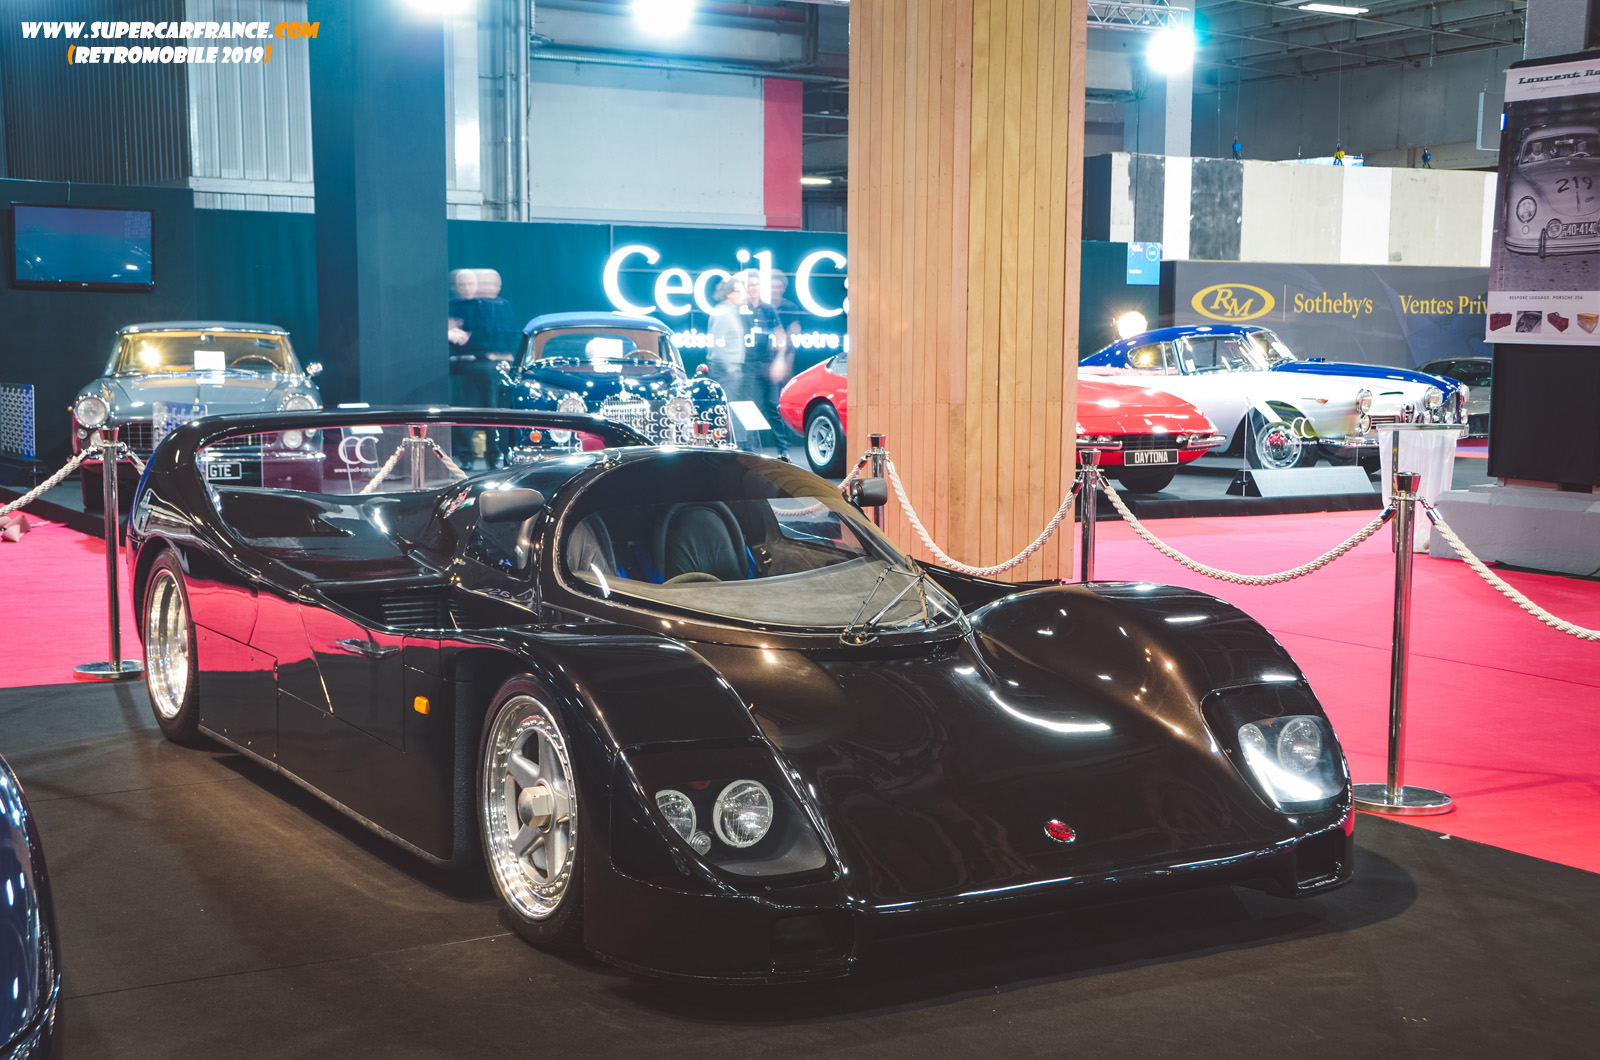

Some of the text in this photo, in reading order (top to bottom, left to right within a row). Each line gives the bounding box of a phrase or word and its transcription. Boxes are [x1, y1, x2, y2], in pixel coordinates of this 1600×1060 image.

[1517, 71, 1581, 85] Laurent
[1555, 176, 1593, 193] 219
[603, 244, 772, 317] Cecil
[1210, 288, 1254, 317] RM
[1293, 291, 1373, 319] Sotheby's
[1399, 294, 1454, 315] Ventes
[790, 331, 840, 349] votre
[1291, 416, 1315, 439] CC
[338, 435, 380, 465] CC
[1134, 451, 1169, 464] DAYTONA
[209, 464, 232, 477] GTE
